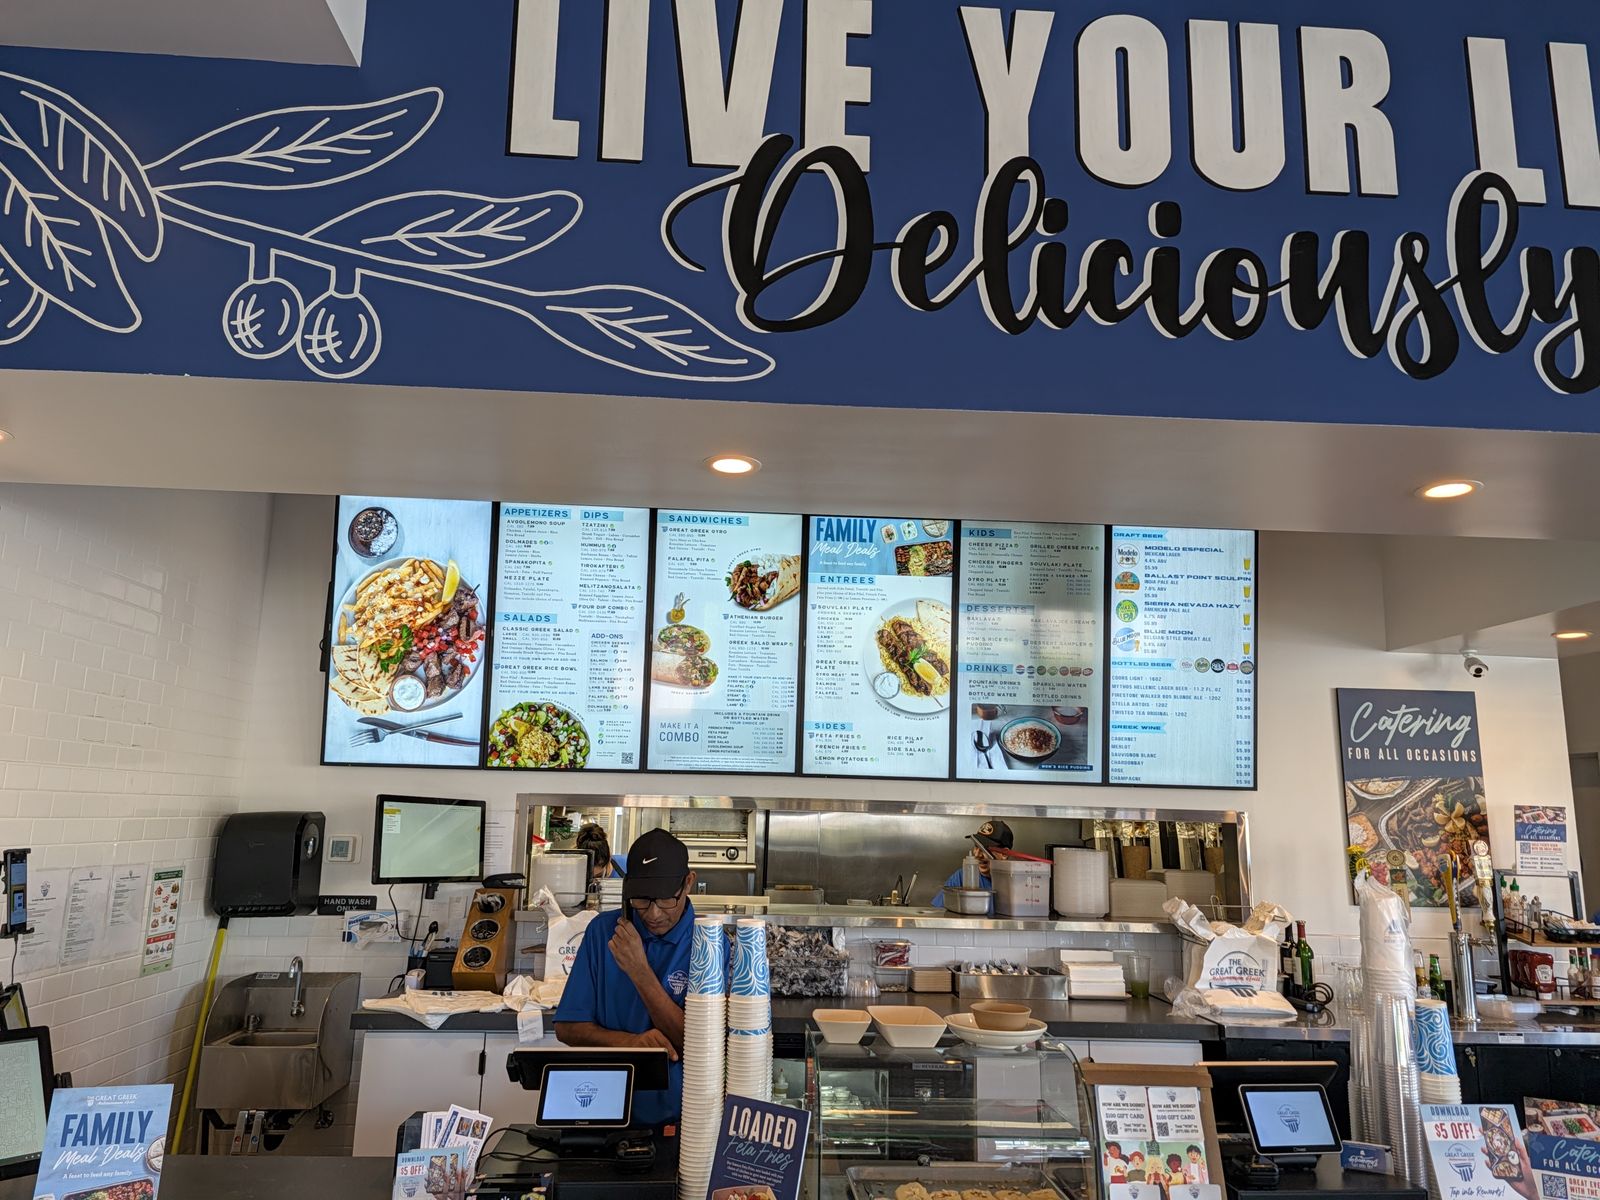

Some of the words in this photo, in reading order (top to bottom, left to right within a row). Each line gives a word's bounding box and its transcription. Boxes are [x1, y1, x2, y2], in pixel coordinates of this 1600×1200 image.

[506, 0, 872, 172] LIVE
[958, 6, 1399, 198] YOUR
[661, 132, 1600, 394] Deliciously
[504, 509, 569, 518] APPETIZERS
[583, 512, 609, 520] DIPS
[669, 515, 742, 525] SANDWICHES
[816, 518, 877, 543] FAMILY
[811, 542, 842, 557] Meal
[845, 542, 880, 559] Deals
[820, 576, 875, 584] ENTREES
[967, 605, 1027, 613] DESSERTS
[504, 614, 551, 623] SALADS
[1351, 702, 1472, 749] Catering
[659, 732, 699, 743] COMBO
[1348, 748, 1371, 760] FOR
[1379, 748, 1399, 761] ALL
[1407, 749, 1477, 763] OCCASIONS
[559, 947, 578, 955] GRE
[1229, 958, 1242, 966] THE
[1209, 967, 1235, 976] GREAT
[1236, 966, 1265, 977] GREEK
[1430, 1106, 1469, 1116] DOWNLOAD
[60, 1110, 154, 1148] FAMILY
[729, 1105, 797, 1151] LOADED
[1435, 1123, 1449, 1139] $5
[1451, 1122, 1475, 1139] OFF!
[53, 1149, 97, 1171] Meal
[100, 1143, 147, 1168] Deals
[723, 1134, 758, 1156] Feta
[755, 1141, 794, 1171] Fries
[400, 1167, 408, 1175] $5
[410, 1165, 425, 1175] OFF!
[1543, 1159, 1560, 1169] FOR
[1565, 1162, 1581, 1172] ALL
[1586, 1165, 1600, 1174] OC
[1449, 1187, 1460, 1198] Tap
